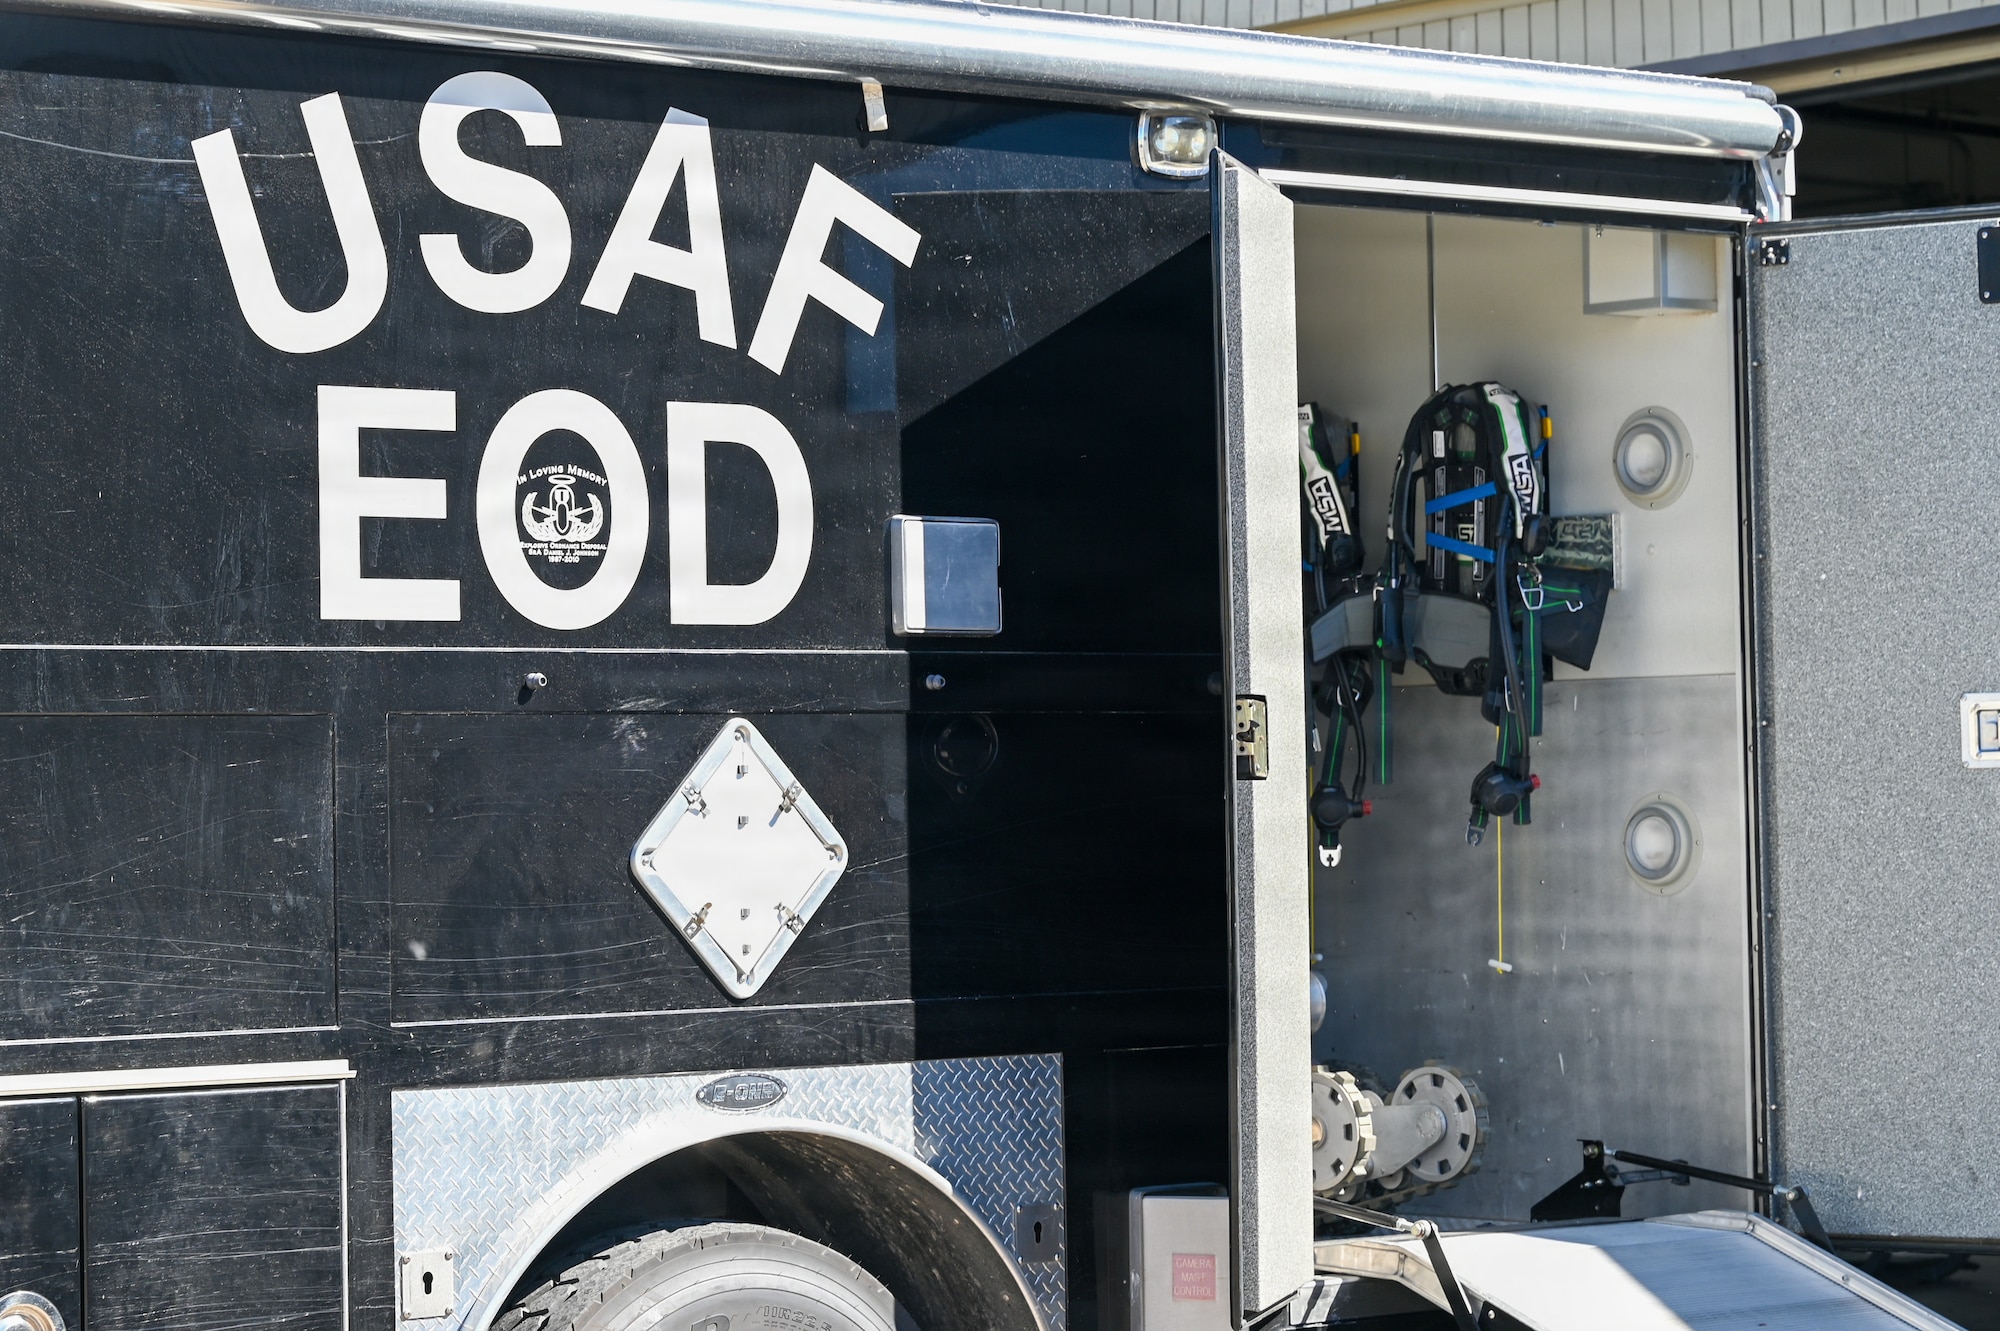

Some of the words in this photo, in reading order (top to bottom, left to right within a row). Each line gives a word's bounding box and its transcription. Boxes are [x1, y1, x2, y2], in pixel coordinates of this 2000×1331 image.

[191, 70, 922, 375] USAF
[529, 465, 564, 479] LOVING
[567, 464, 608, 486] MEMORY
[1511, 454, 1533, 517] MSA
[316, 385, 815, 631] EOD
[1310, 476, 1342, 533] MSA
[1175, 1258, 1212, 1268] CAMERA
[1181, 1272, 1206, 1282] MAST
[1174, 1286, 1214, 1297] CONTROL
